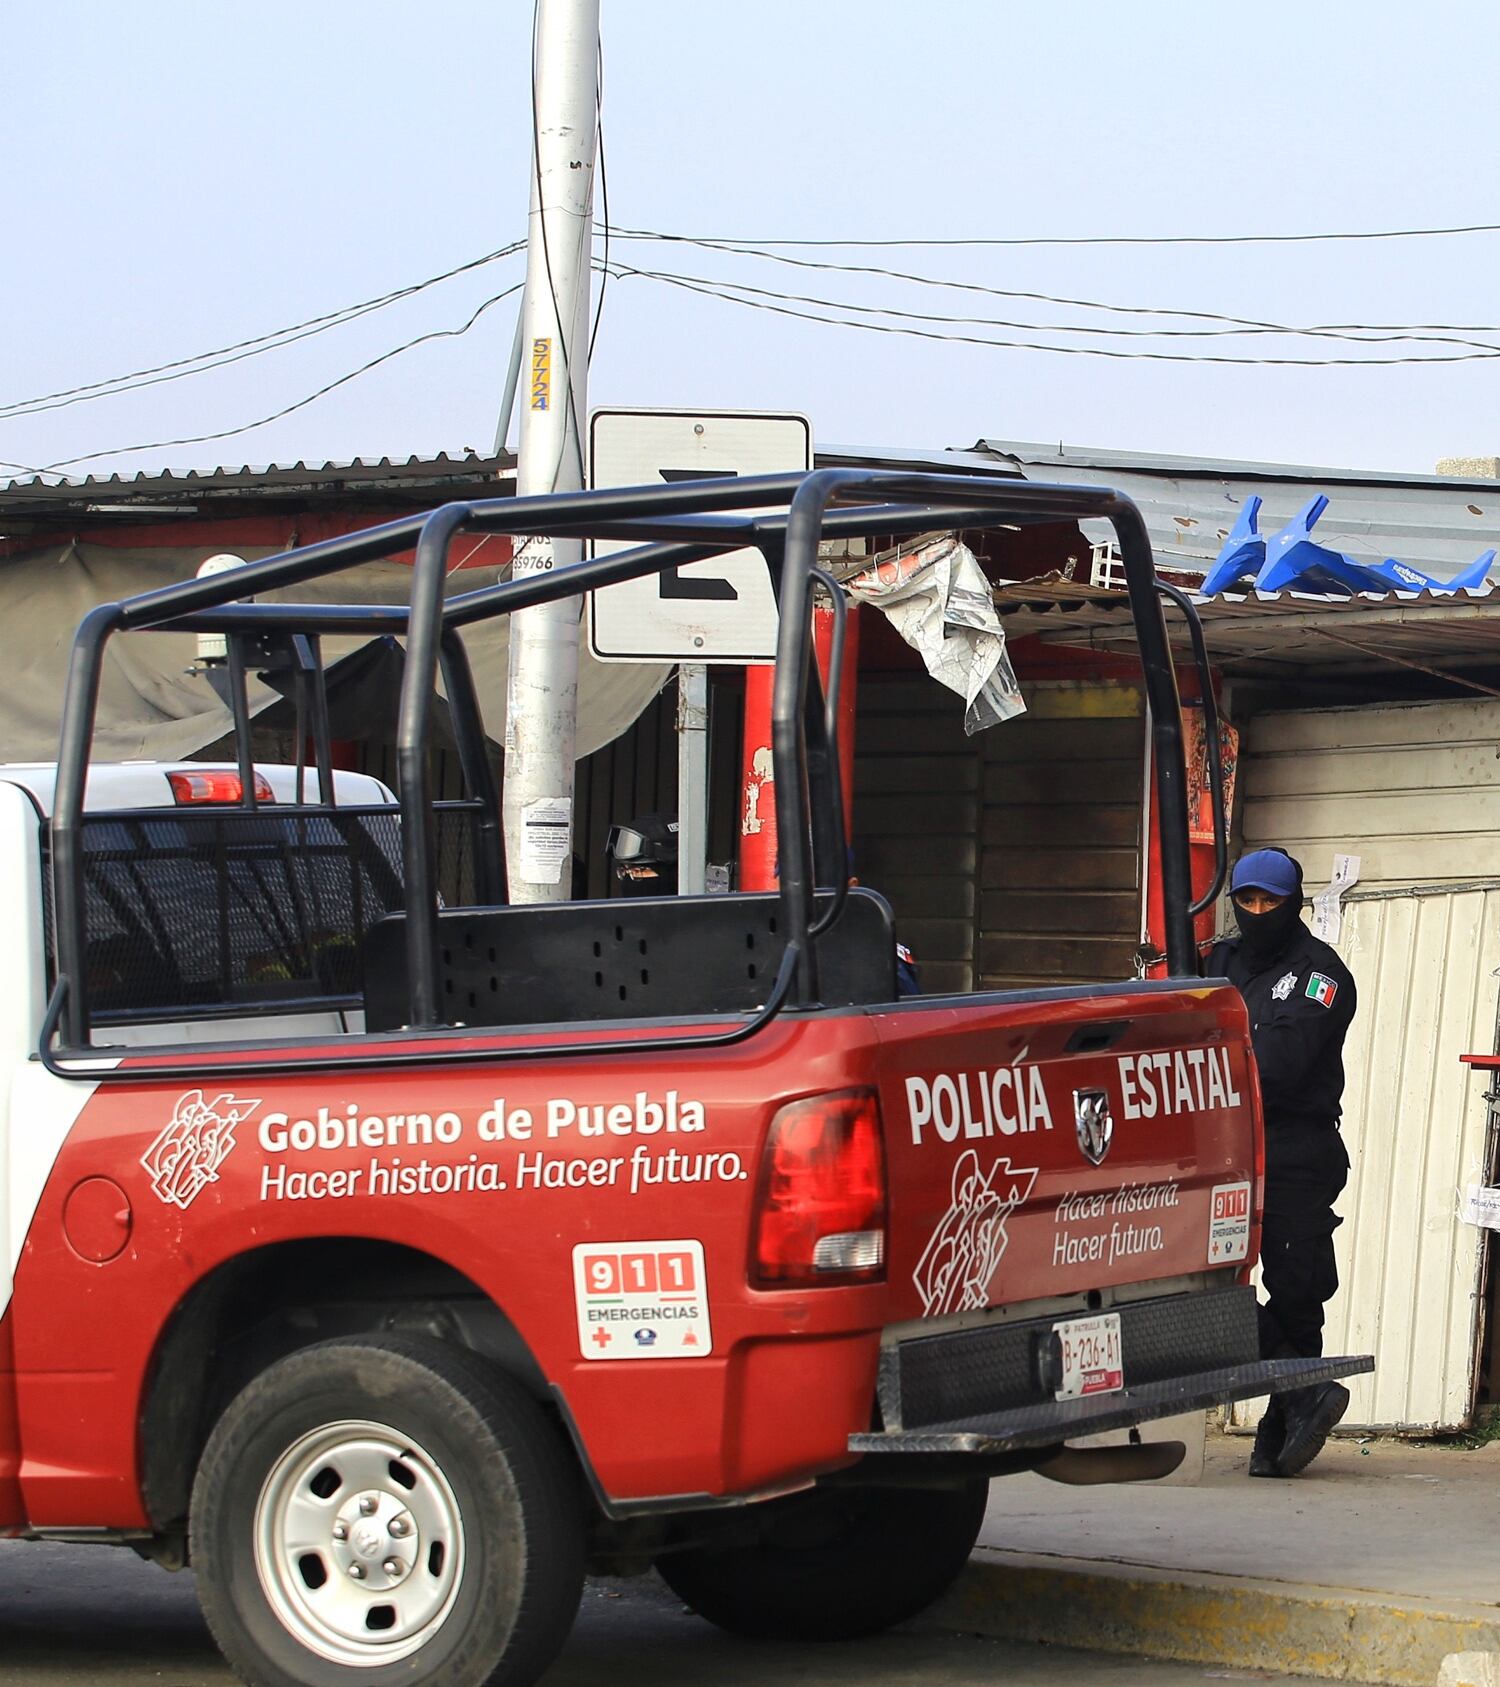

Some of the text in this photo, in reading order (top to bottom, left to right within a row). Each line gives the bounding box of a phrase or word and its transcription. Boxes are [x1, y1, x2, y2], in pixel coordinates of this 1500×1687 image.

[532, 338, 549, 410] 57724
[905, 1045, 1240, 1145] POLICÍA ESTATAL
[258, 1090, 705, 1152] Gobierno de Puebla
[260, 1145, 748, 1200] Hacer historia. Hacer futuro.
[1054, 1176, 1179, 1223] Hacer historia.
[1216, 1193, 1245, 1216] 911
[1052, 1222, 1164, 1266] Hacer futuro.
[1212, 1224, 1247, 1238] EMERGENCIAS
[591, 1257, 684, 1290] 911
[587, 1306, 699, 1322] EMERGENCIAS
[1082, 1373, 1105, 1386] PUEBLA
